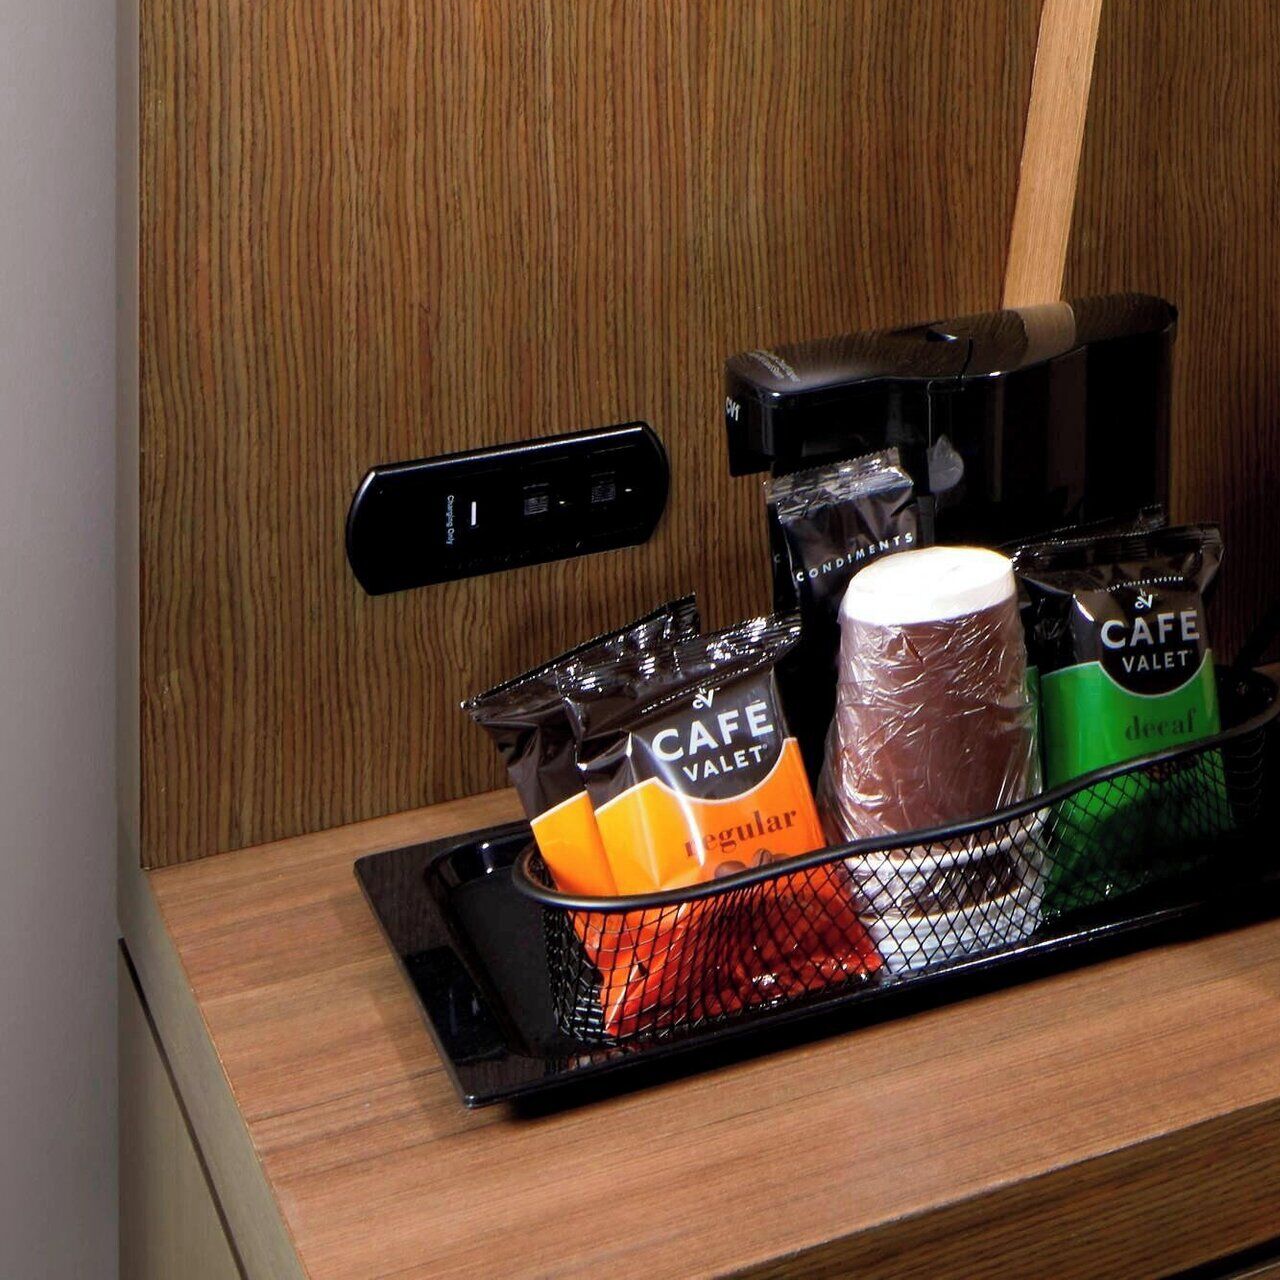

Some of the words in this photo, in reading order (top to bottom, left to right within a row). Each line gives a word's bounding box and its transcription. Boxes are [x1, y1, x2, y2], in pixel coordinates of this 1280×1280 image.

[795, 531, 914, 583] CONDIMENTS
[1122, 650, 1188, 674] VALET
[1124, 705, 1197, 742] decaf
[682, 745, 763, 783] VALET
